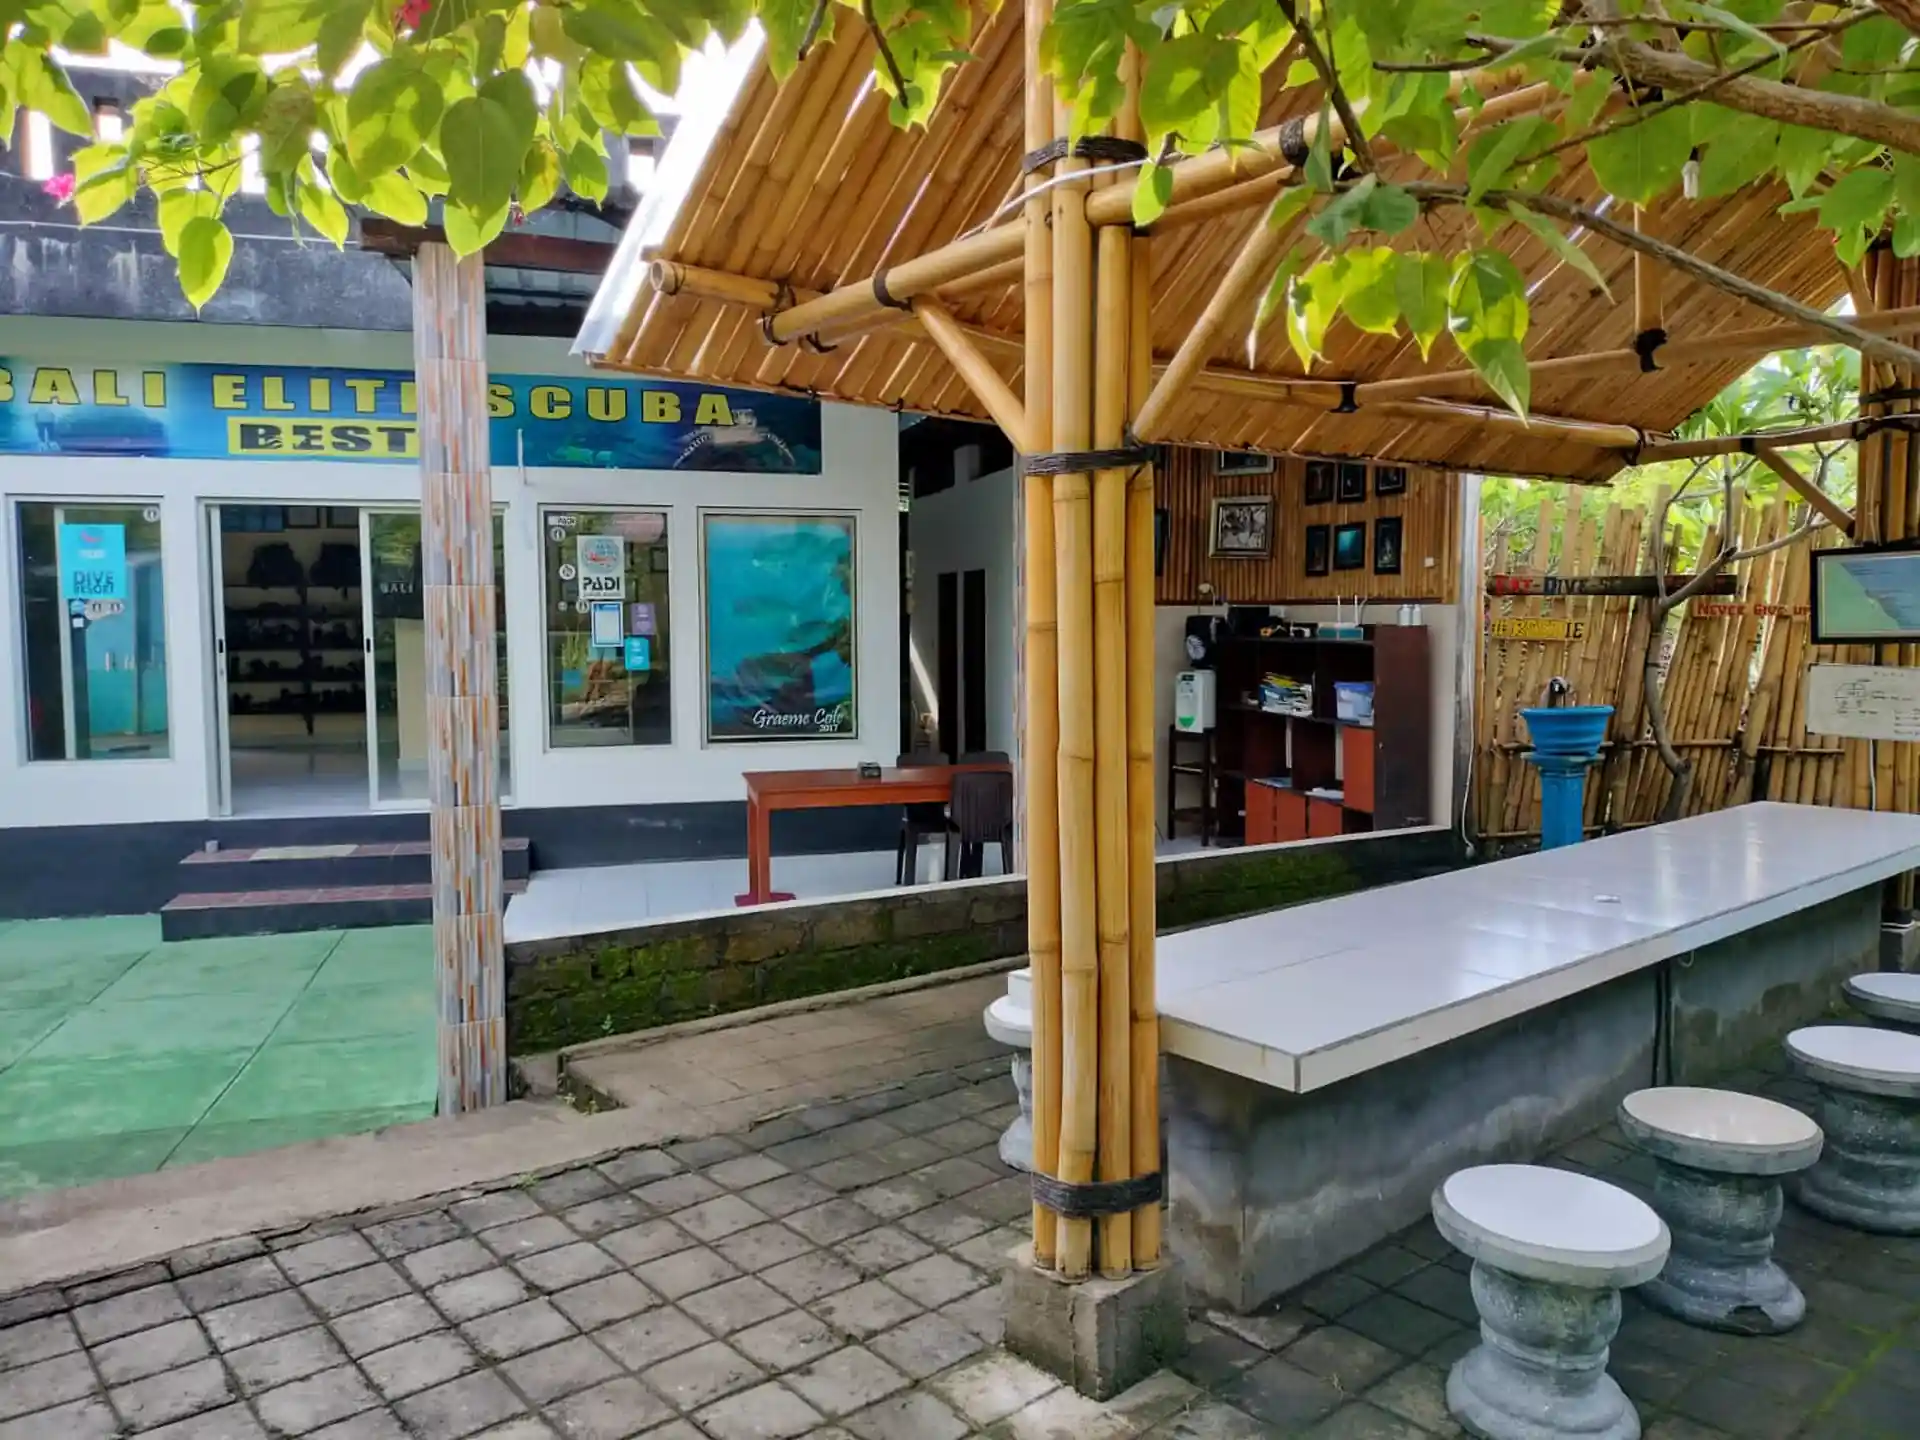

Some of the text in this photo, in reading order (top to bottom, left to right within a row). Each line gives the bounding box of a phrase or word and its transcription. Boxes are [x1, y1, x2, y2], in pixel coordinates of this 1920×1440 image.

[488, 382, 735, 426] SCUBA
[240, 423, 416, 453] BEST
[73, 571, 114, 586] DIVE
[583, 576, 620, 591] PADI
